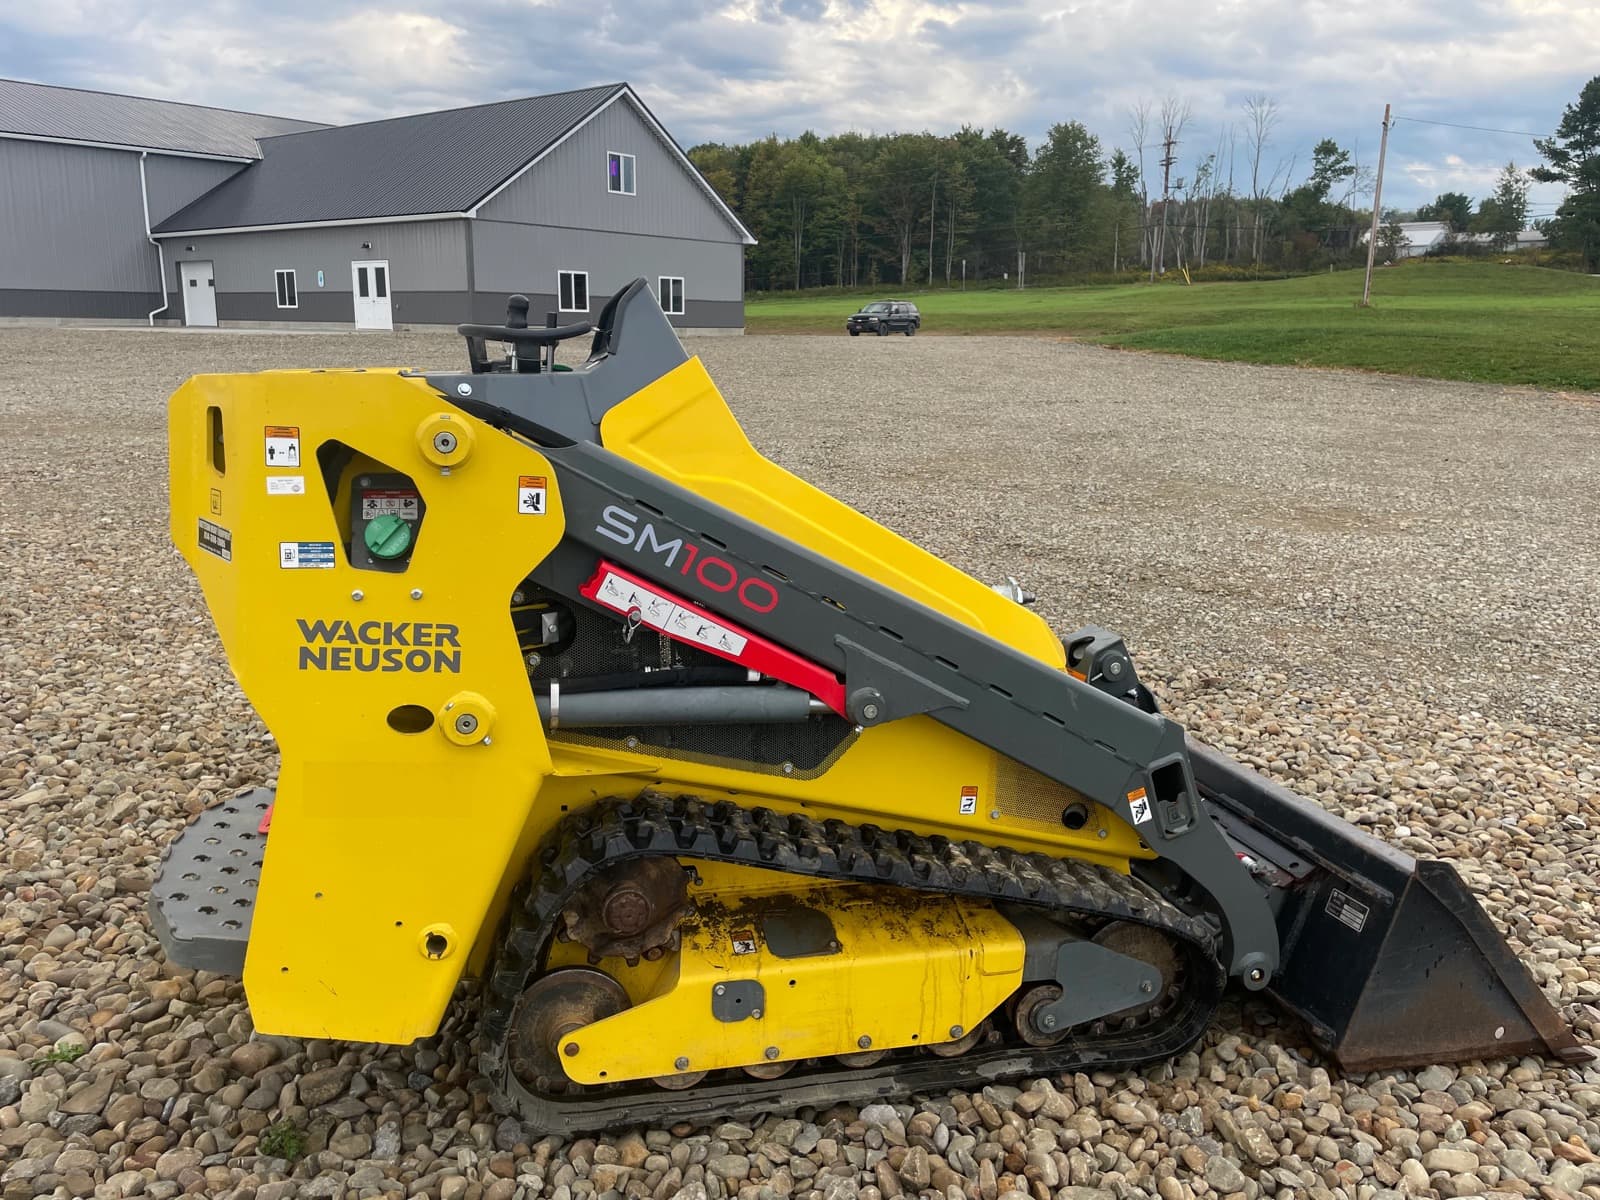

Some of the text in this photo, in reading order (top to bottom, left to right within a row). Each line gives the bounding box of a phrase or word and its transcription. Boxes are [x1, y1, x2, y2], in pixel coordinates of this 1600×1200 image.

[595, 505, 779, 613] SM100
[296, 619, 461, 647] WACKER
[299, 646, 461, 673] NEUSON
